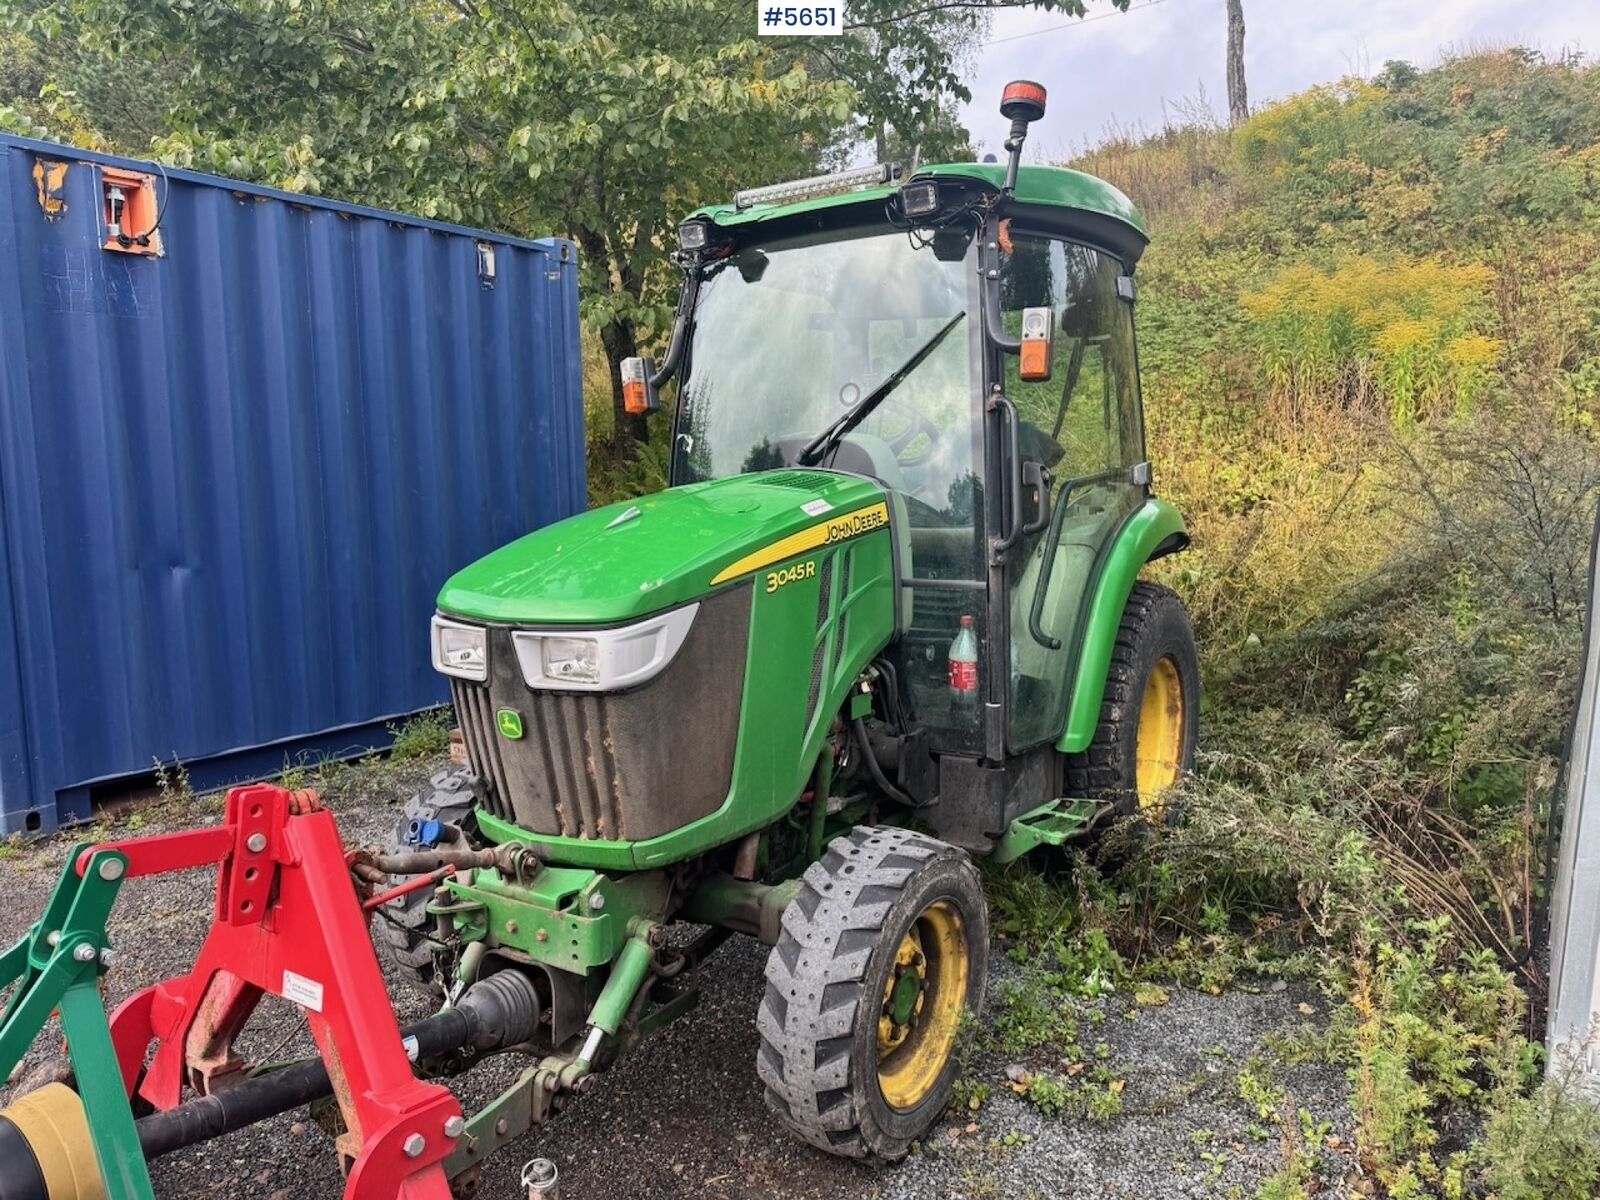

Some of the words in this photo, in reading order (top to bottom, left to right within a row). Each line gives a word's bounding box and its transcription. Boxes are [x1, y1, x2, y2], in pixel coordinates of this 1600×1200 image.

[824, 520, 853, 544] JOHN
[852, 511, 884, 534] DEERE
[766, 561, 815, 593] 3045R
